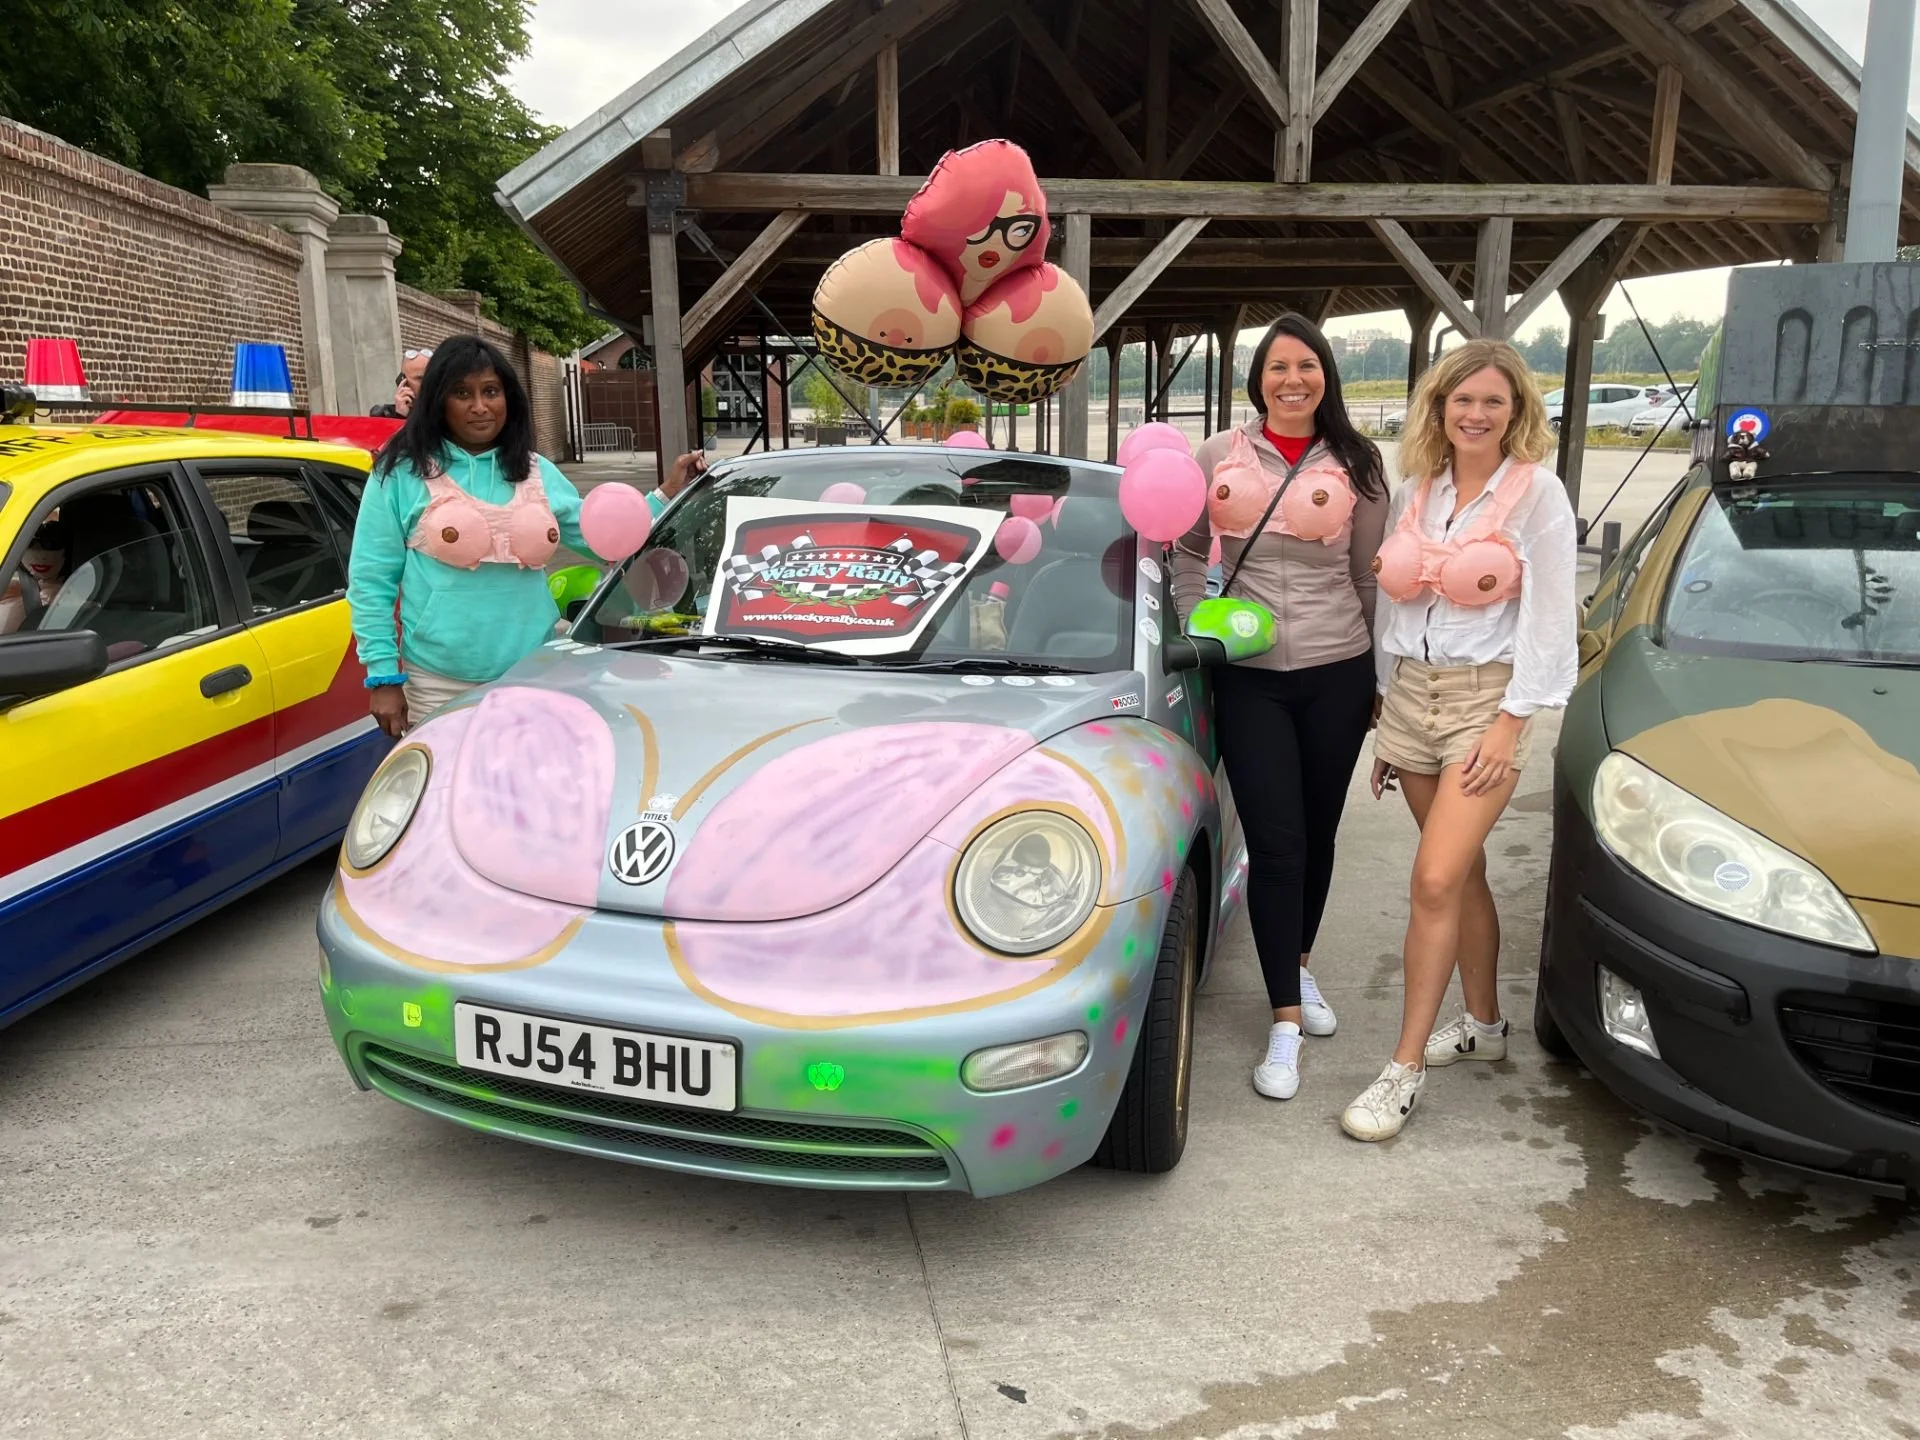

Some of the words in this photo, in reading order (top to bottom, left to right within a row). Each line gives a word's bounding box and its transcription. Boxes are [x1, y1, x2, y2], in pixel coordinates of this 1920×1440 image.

[761, 563, 844, 582] Wacky
[845, 563, 916, 587] Rally
[743, 612, 895, 627] www.wackyrally.co.uk
[1118, 695, 1138, 707] BOOBS
[474, 1013, 597, 1080] RJ54
[612, 1036, 712, 1097] BHU
